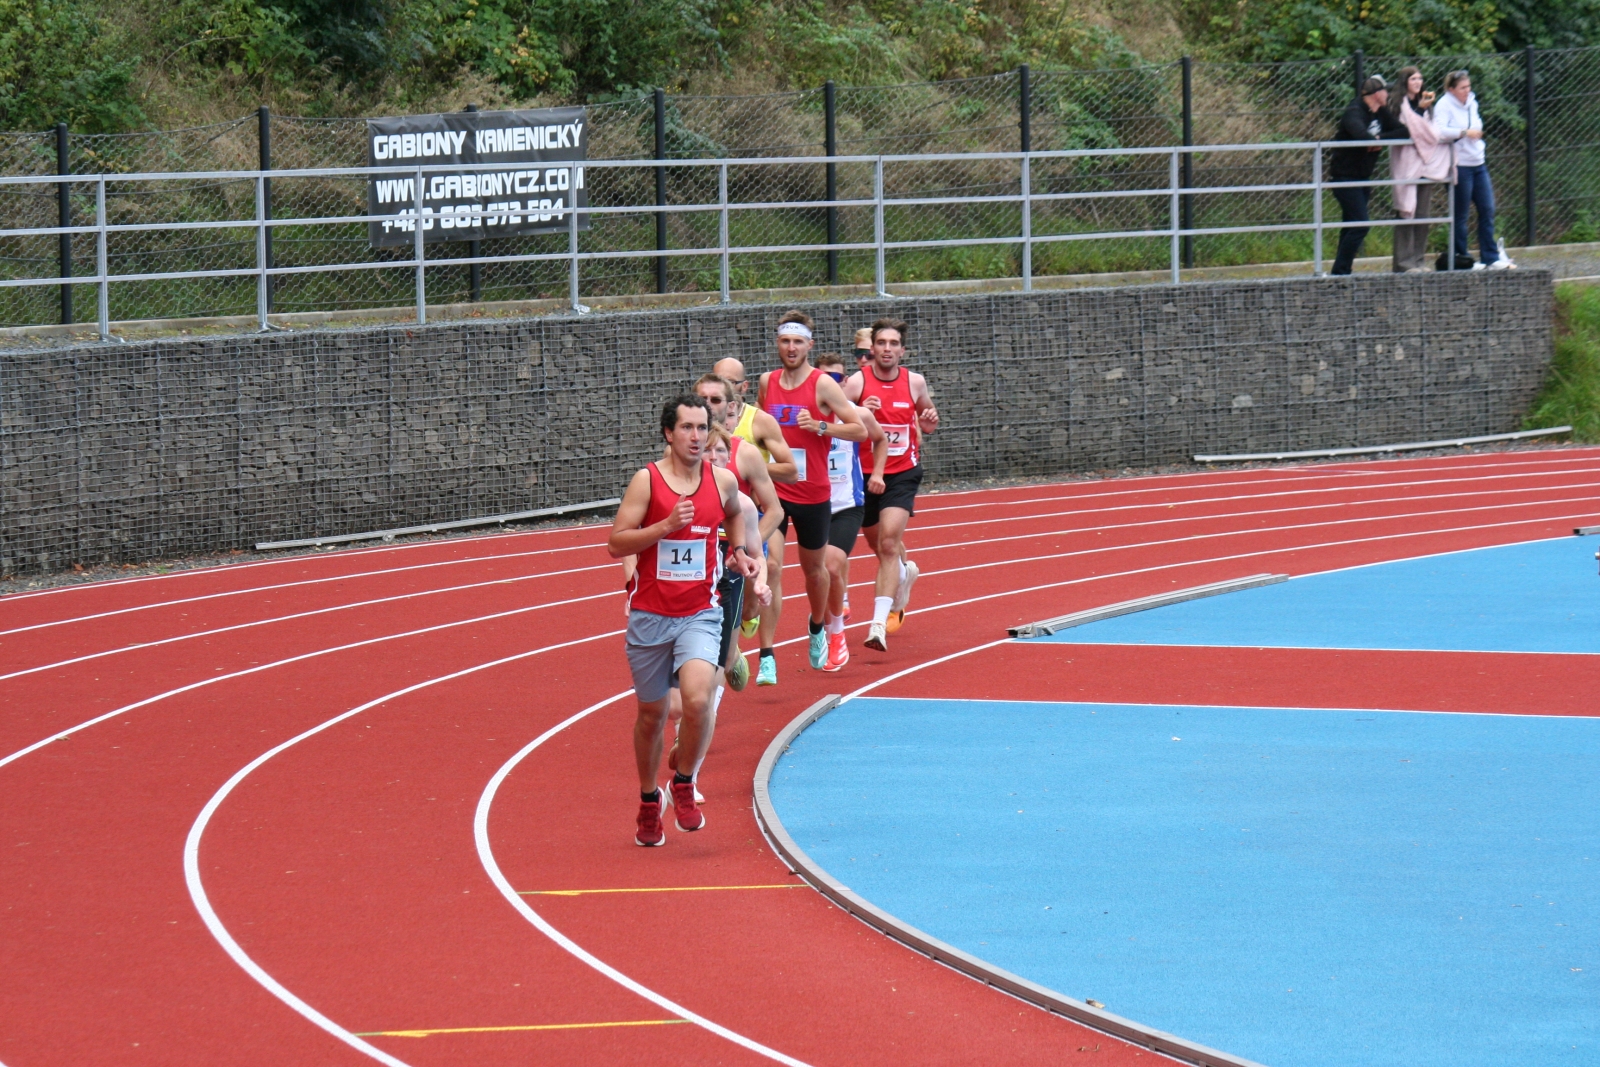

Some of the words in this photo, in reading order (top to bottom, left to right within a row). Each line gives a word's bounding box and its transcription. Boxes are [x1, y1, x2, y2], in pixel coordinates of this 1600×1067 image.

[373, 130, 467, 160] GABIONY
[475, 119, 583, 154] KAMENICKÝ
[486, 201, 522, 226] 572
[671, 548, 693, 565] 14
